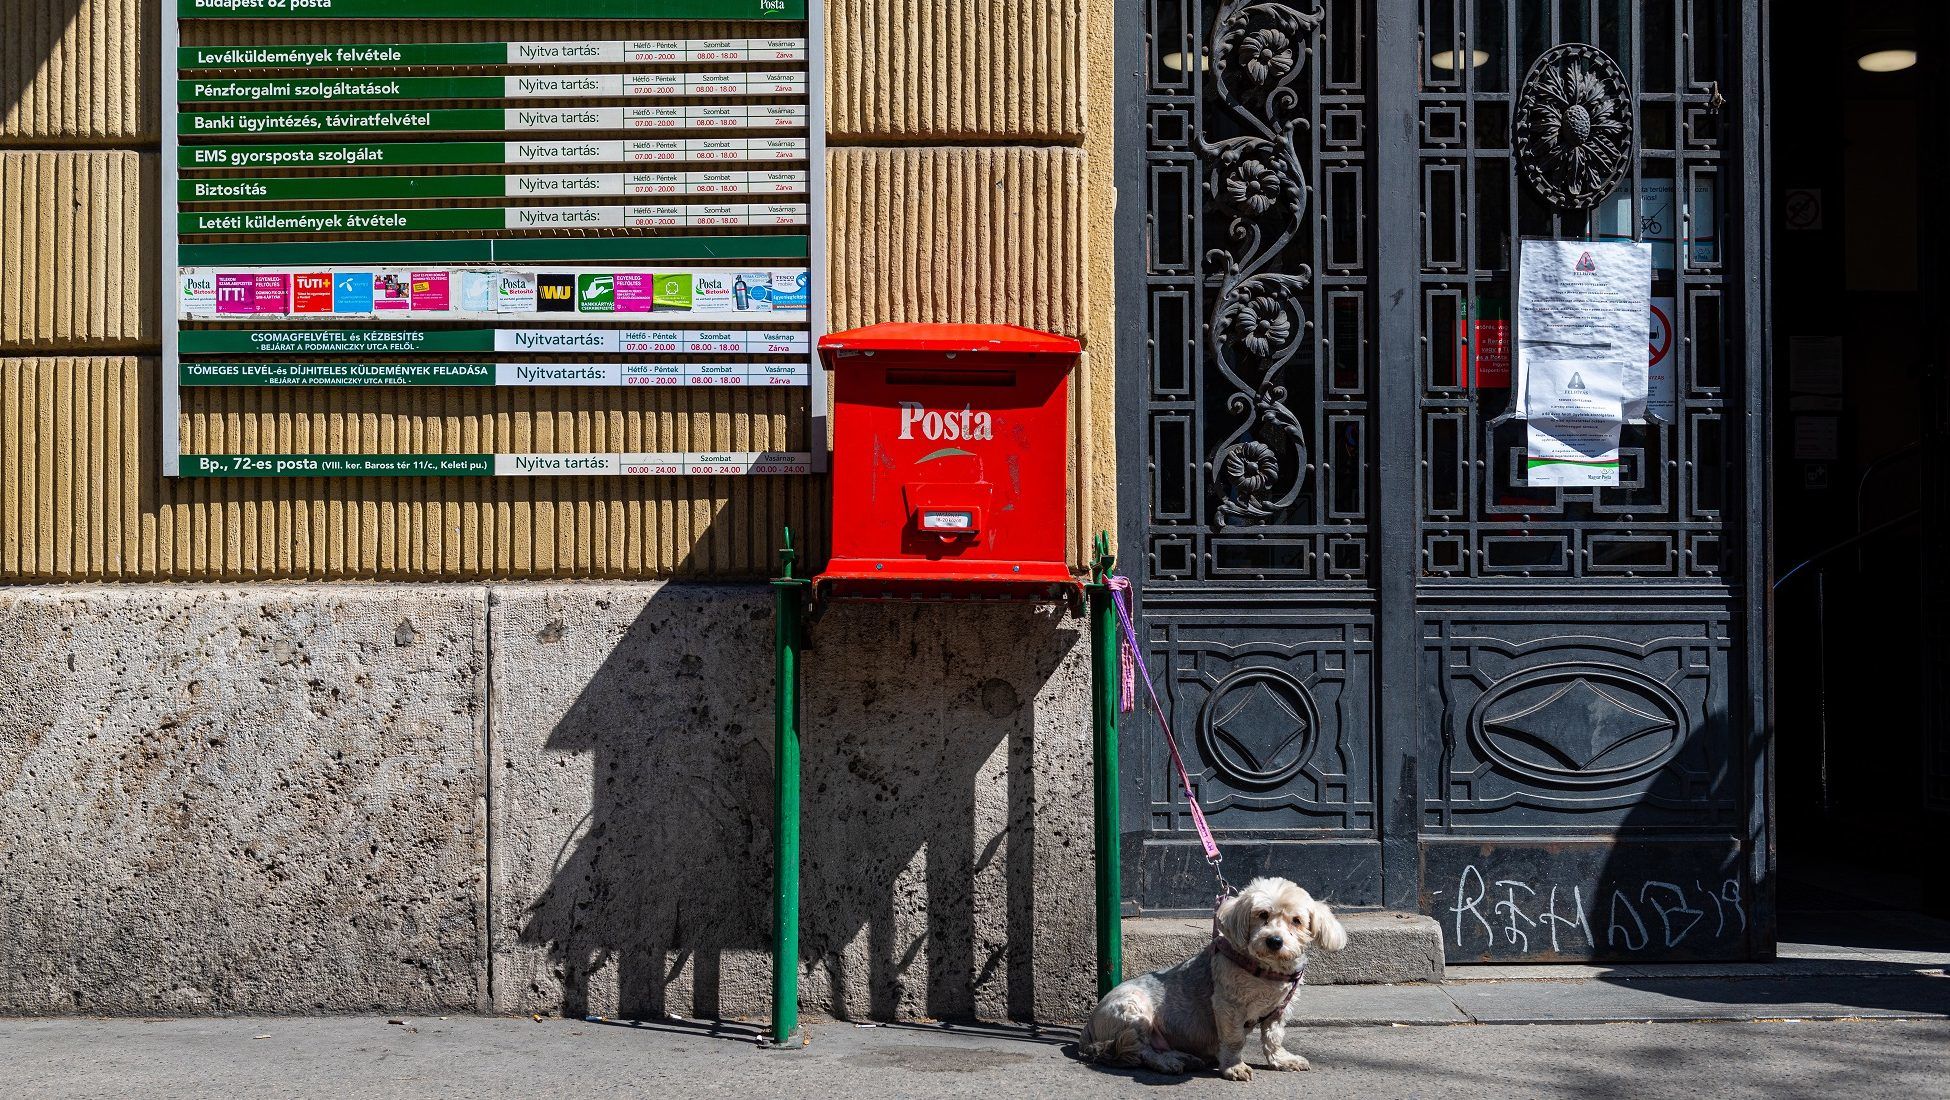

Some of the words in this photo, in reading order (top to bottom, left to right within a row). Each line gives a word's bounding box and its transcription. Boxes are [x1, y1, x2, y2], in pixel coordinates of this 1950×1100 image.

[196, 0, 264, 10] Budapest
[290, 0, 331, 11] posta
[760, 0, 784, 9] Posta
[767, 40, 796, 48] Vasárnap
[198, 48, 332, 65] Levélküldemények
[336, 48, 401, 61] felvétele
[520, 45, 558, 59] Nyitva
[562, 44, 600, 56] tartás:
[702, 74, 730, 82] Szombat
[766, 74, 794, 82] Vasárnap
[195, 83, 290, 98] Pénzforgalmi
[295, 81, 400, 98] szolgáltatások
[519, 78, 558, 92] Nyitva
[560, 78, 598, 90] tartás:
[656, 108, 677, 116] Péntek
[766, 107, 795, 115] Vasárnap
[195, 116, 234, 128] Banki
[239, 114, 321, 130] ügyintézés,
[326, 113, 430, 126] táviratfelvétel
[520, 112, 558, 125] Nyitva
[561, 111, 599, 123] tartás:
[196, 150, 227, 162] EMS
[231, 150, 314, 165] gyorsposta
[318, 148, 383, 164] szolgálat
[520, 145, 558, 158] Nyitva
[561, 144, 599, 156] tartás:
[196, 183, 267, 196] Biztosítás
[520, 178, 558, 191] Nyitva
[561, 177, 599, 189] tartás:
[704, 206, 731, 214] Szombat
[768, 205, 796, 213] Vasárnap
[200, 216, 240, 228] Letéti
[246, 215, 342, 230] küldemények
[347, 215, 406, 226] átvétele
[520, 210, 558, 224] Nyitva
[562, 210, 600, 222] tartás:
[776, 216, 794, 224] Zárva
[187, 278, 211, 289] Posta
[297, 278, 331, 289] TUTI+
[502, 277, 526, 289] Posta
[699, 278, 722, 289] Posta
[218, 287, 245, 302] ITT!
[544, 285, 571, 300] WU
[251, 331, 347, 342] CSOMAGFELVÉTEL
[350, 332, 360, 341] és
[364, 331, 424, 341] KÉZBESÍTÉS
[516, 333, 604, 347] Nyitvatartás:
[652, 332, 677, 340] Péntek
[700, 332, 731, 340] Szombat
[764, 333, 794, 341] Vasárnap
[768, 344, 789, 352] Zárva
[187, 364, 239, 375] TÖMEGES
[242, 364, 287, 375] LEVÉL-és
[290, 364, 347, 375] DÍJHITELES
[350, 364, 430, 375] KÜLDEMÉNYEK
[434, 364, 488, 375] FELADÁSA
[517, 366, 605, 381] Nyitvatartás:
[765, 366, 795, 375] Vasárnap
[692, 376, 712, 384] 08.00
[720, 376, 740, 384] 18.00
[770, 376, 790, 384] Zárva
[897, 401, 993, 441] Posta
[516, 456, 560, 470] Nyitva
[564, 456, 608, 468] tartás:
[764, 454, 795, 463] Vasárnap
[200, 458, 228, 473] Bp.,
[233, 457, 272, 470] 72-es
[277, 458, 317, 472] posta
[322, 462, 342, 470] (VIII.
[346, 461, 362, 469] ker.
[365, 461, 394, 469] Baross
[396, 461, 410, 469] tér
[413, 461, 438, 470] 11/c.,
[441, 460, 467, 469] Keleti
[470, 461, 487, 470] pu.)
[628, 466, 648, 474] 00.00
[656, 466, 676, 474] 24.00
[692, 466, 713, 474] 00.00
[720, 466, 740, 474] 24.00
